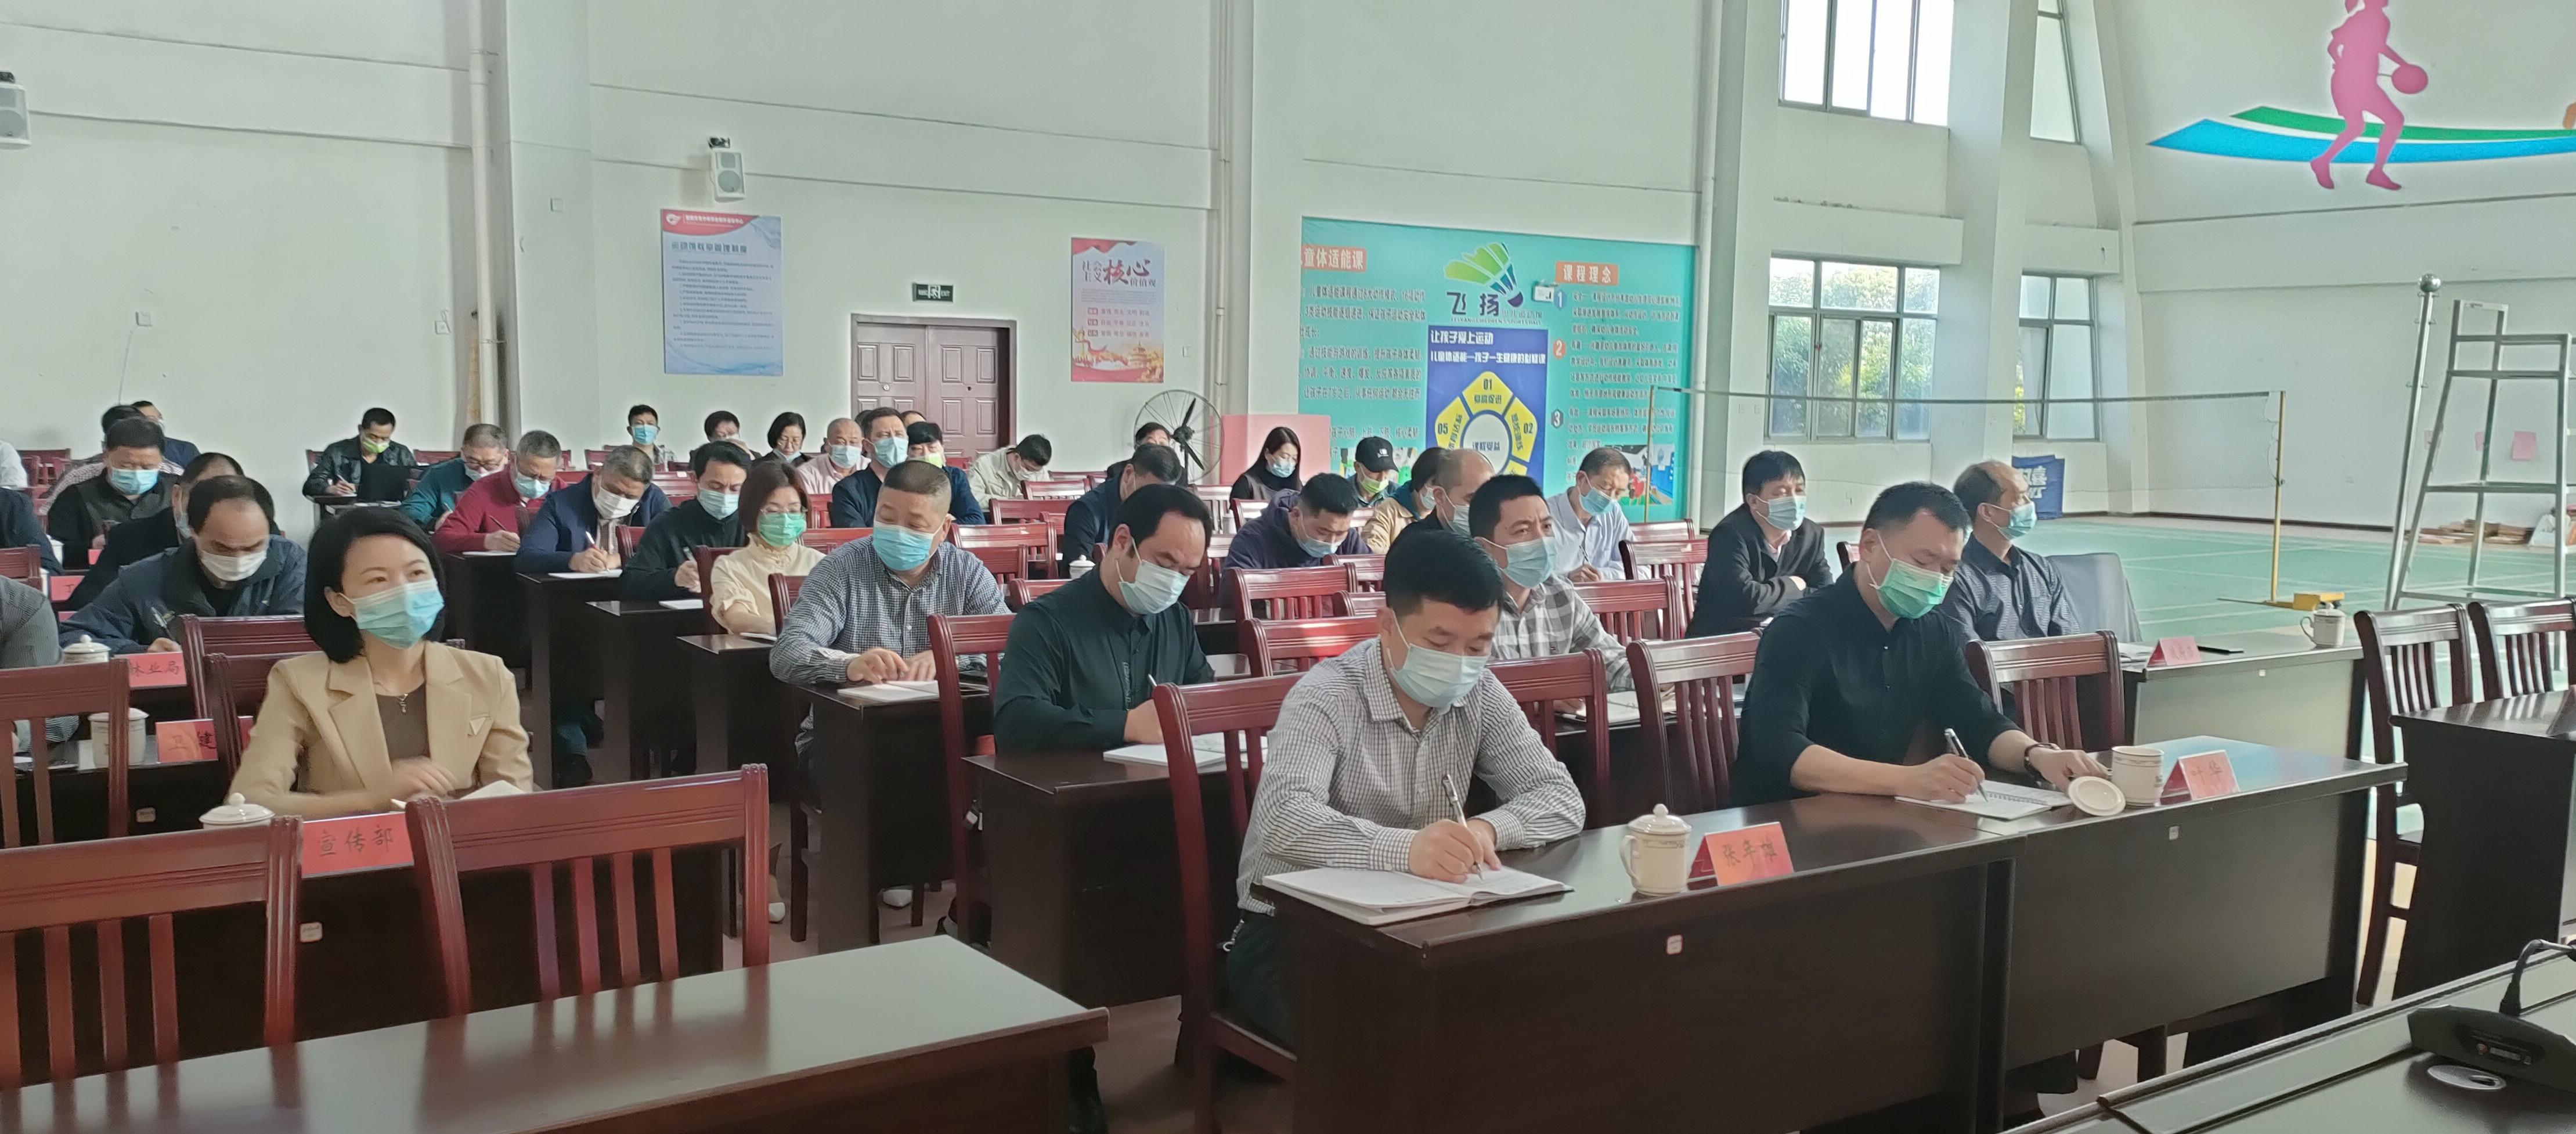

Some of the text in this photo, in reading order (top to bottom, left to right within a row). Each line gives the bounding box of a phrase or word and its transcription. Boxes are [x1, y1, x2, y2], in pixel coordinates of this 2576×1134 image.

[1301, 247, 1363, 269] 童体适能课
[1103, 258, 1151, 285] 核心
[1563, 264, 1611, 283] 课程理念
[1446, 291, 1499, 316] 飞扬
[1557, 291, 1563, 308] 1
[1430, 329, 1494, 345] 让孩子爱上运动
[1556, 340, 1563, 357] 2
[1483, 378, 1492, 390] 01
[1553, 410, 1560, 427] 3
[1438, 423, 1448, 434] 05
[1523, 423, 1534, 434] 02
[319, 825, 394, 856] 宣传部
